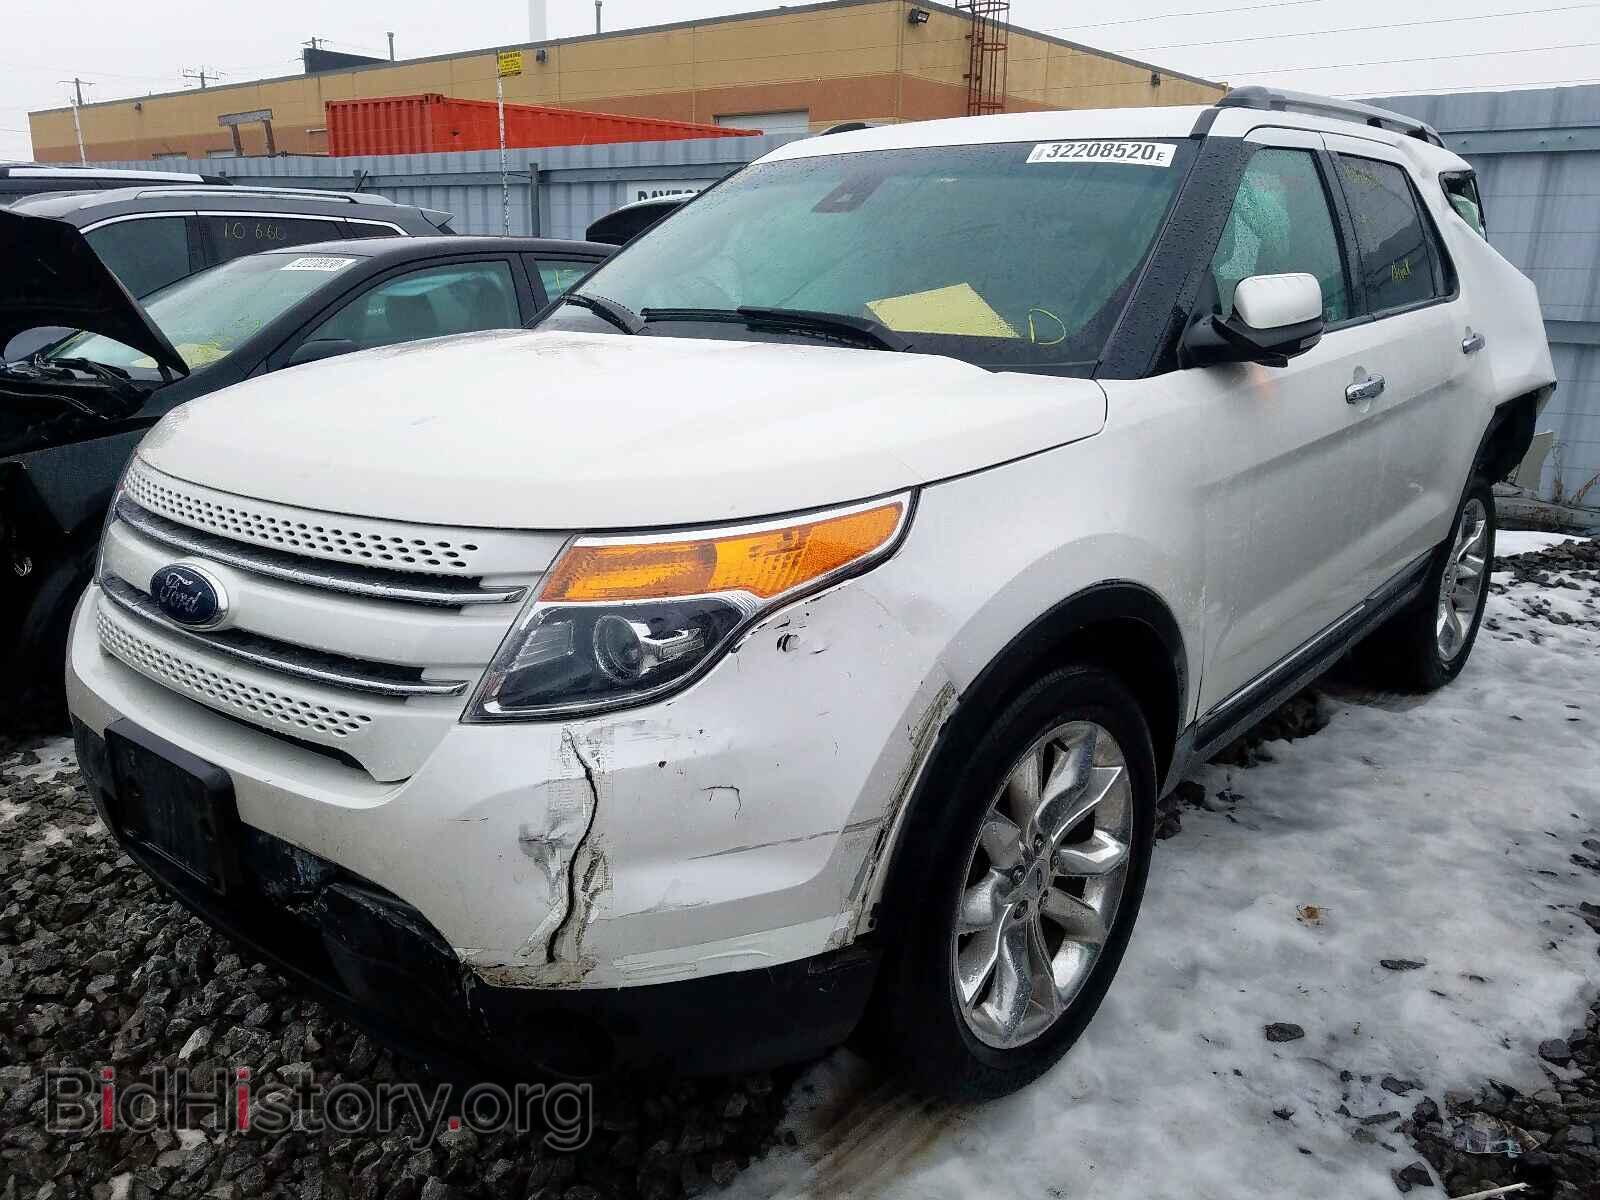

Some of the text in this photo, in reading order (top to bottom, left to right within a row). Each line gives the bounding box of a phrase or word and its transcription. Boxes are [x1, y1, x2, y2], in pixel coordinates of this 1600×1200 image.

[1046, 143, 1156, 160] 32208520
[1156, 152, 1166, 161] E
[1028, 308, 1067, 345] D
[159, 572, 203, 614] Ford
